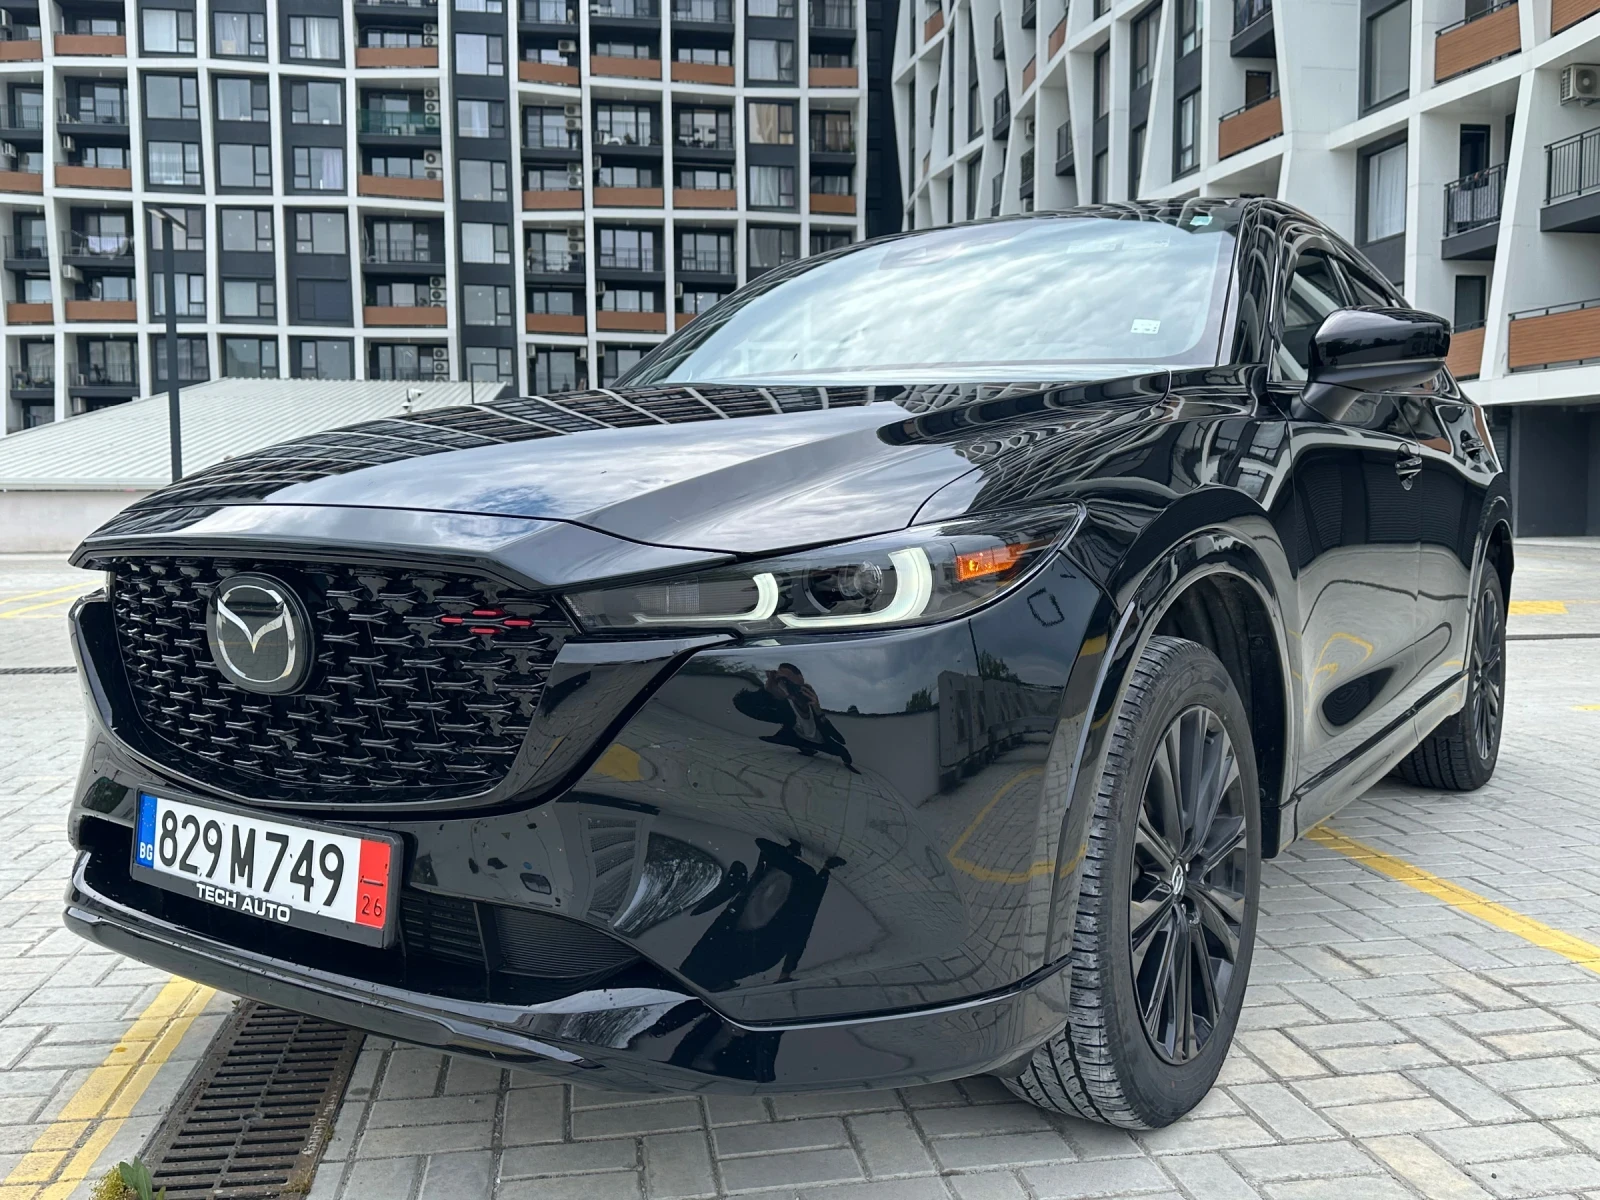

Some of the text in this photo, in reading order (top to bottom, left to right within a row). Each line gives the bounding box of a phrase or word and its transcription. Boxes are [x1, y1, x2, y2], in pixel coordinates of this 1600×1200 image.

[140, 841, 153, 860] BG
[196, 883, 290, 922] TECH AUTO
[361, 895, 383, 917] 26
